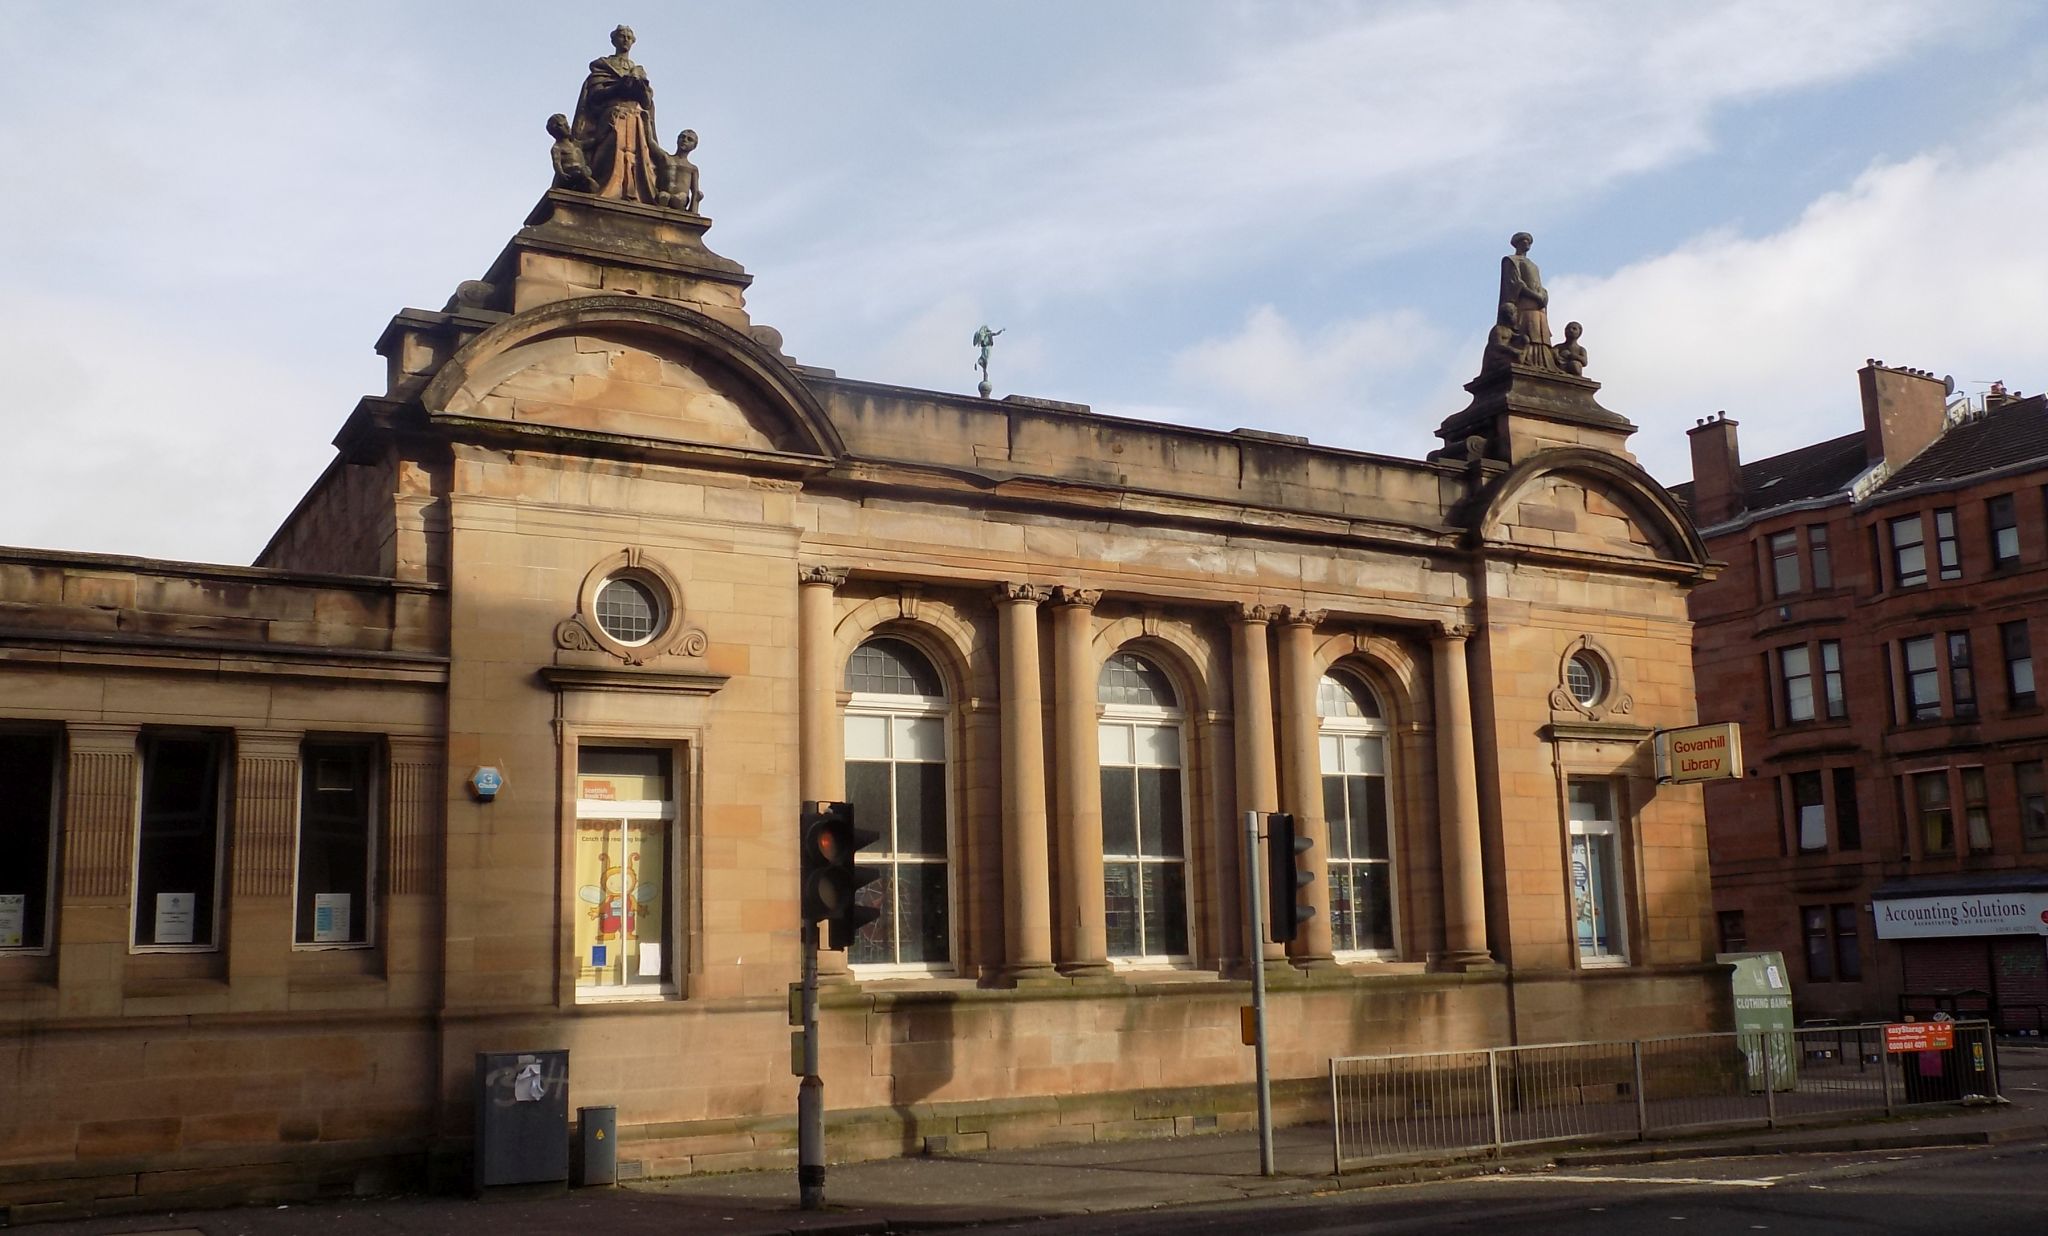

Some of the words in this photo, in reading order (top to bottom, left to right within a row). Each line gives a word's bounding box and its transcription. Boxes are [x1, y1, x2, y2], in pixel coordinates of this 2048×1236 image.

[1674, 736, 1725, 753] Govanhill
[1681, 758, 1720, 772] Library
[1885, 902, 1958, 926] Accounting
[1962, 899, 2026, 918] Solutions
[1736, 998, 1769, 1008] CLOTHING
